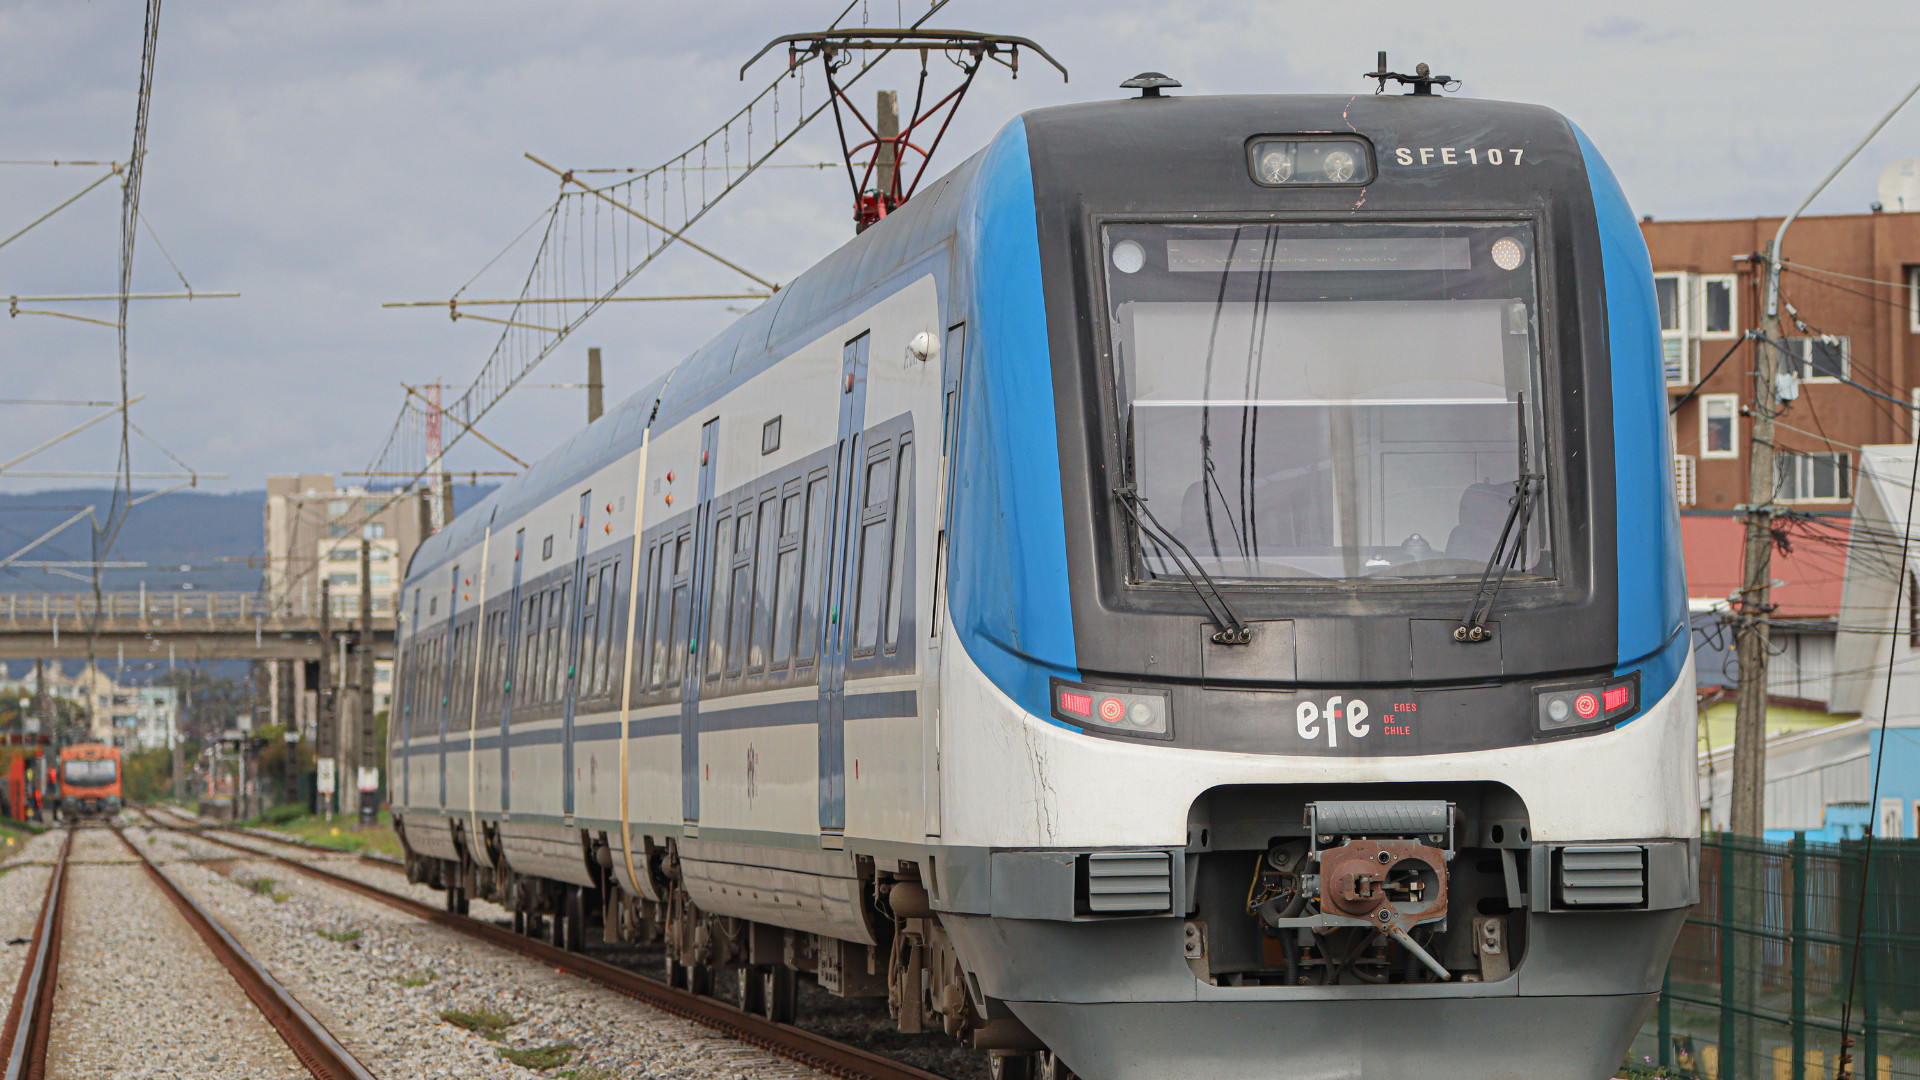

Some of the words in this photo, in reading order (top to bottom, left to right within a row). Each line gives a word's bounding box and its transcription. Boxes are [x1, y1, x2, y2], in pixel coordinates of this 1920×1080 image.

[1395, 147, 1524, 166] SFE107
[1296, 695, 1370, 748] efe
[1383, 714, 1395, 724] DE
[1384, 725, 1411, 735] CHILE
